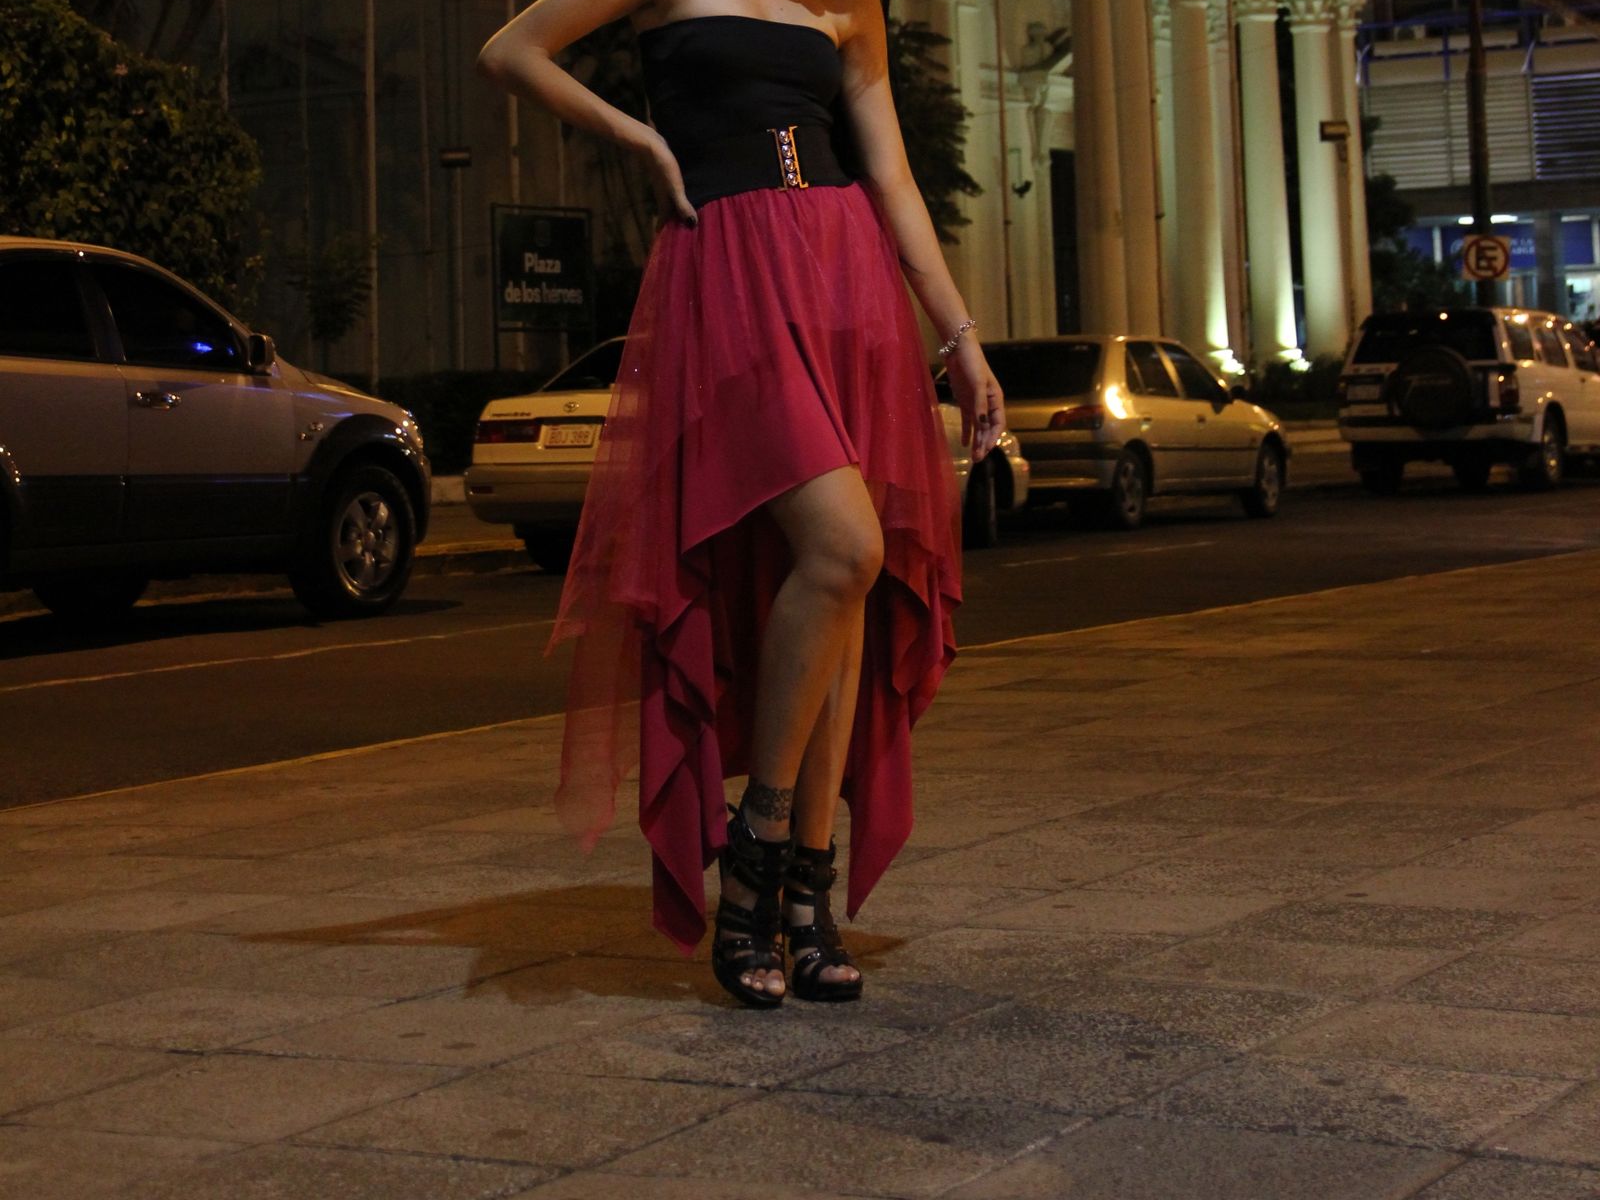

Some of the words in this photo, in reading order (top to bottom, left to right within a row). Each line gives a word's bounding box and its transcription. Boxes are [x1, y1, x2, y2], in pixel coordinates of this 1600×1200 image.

[524, 251, 561, 273] Plaza
[504, 280, 521, 303] de
[521, 280, 541, 303] los
